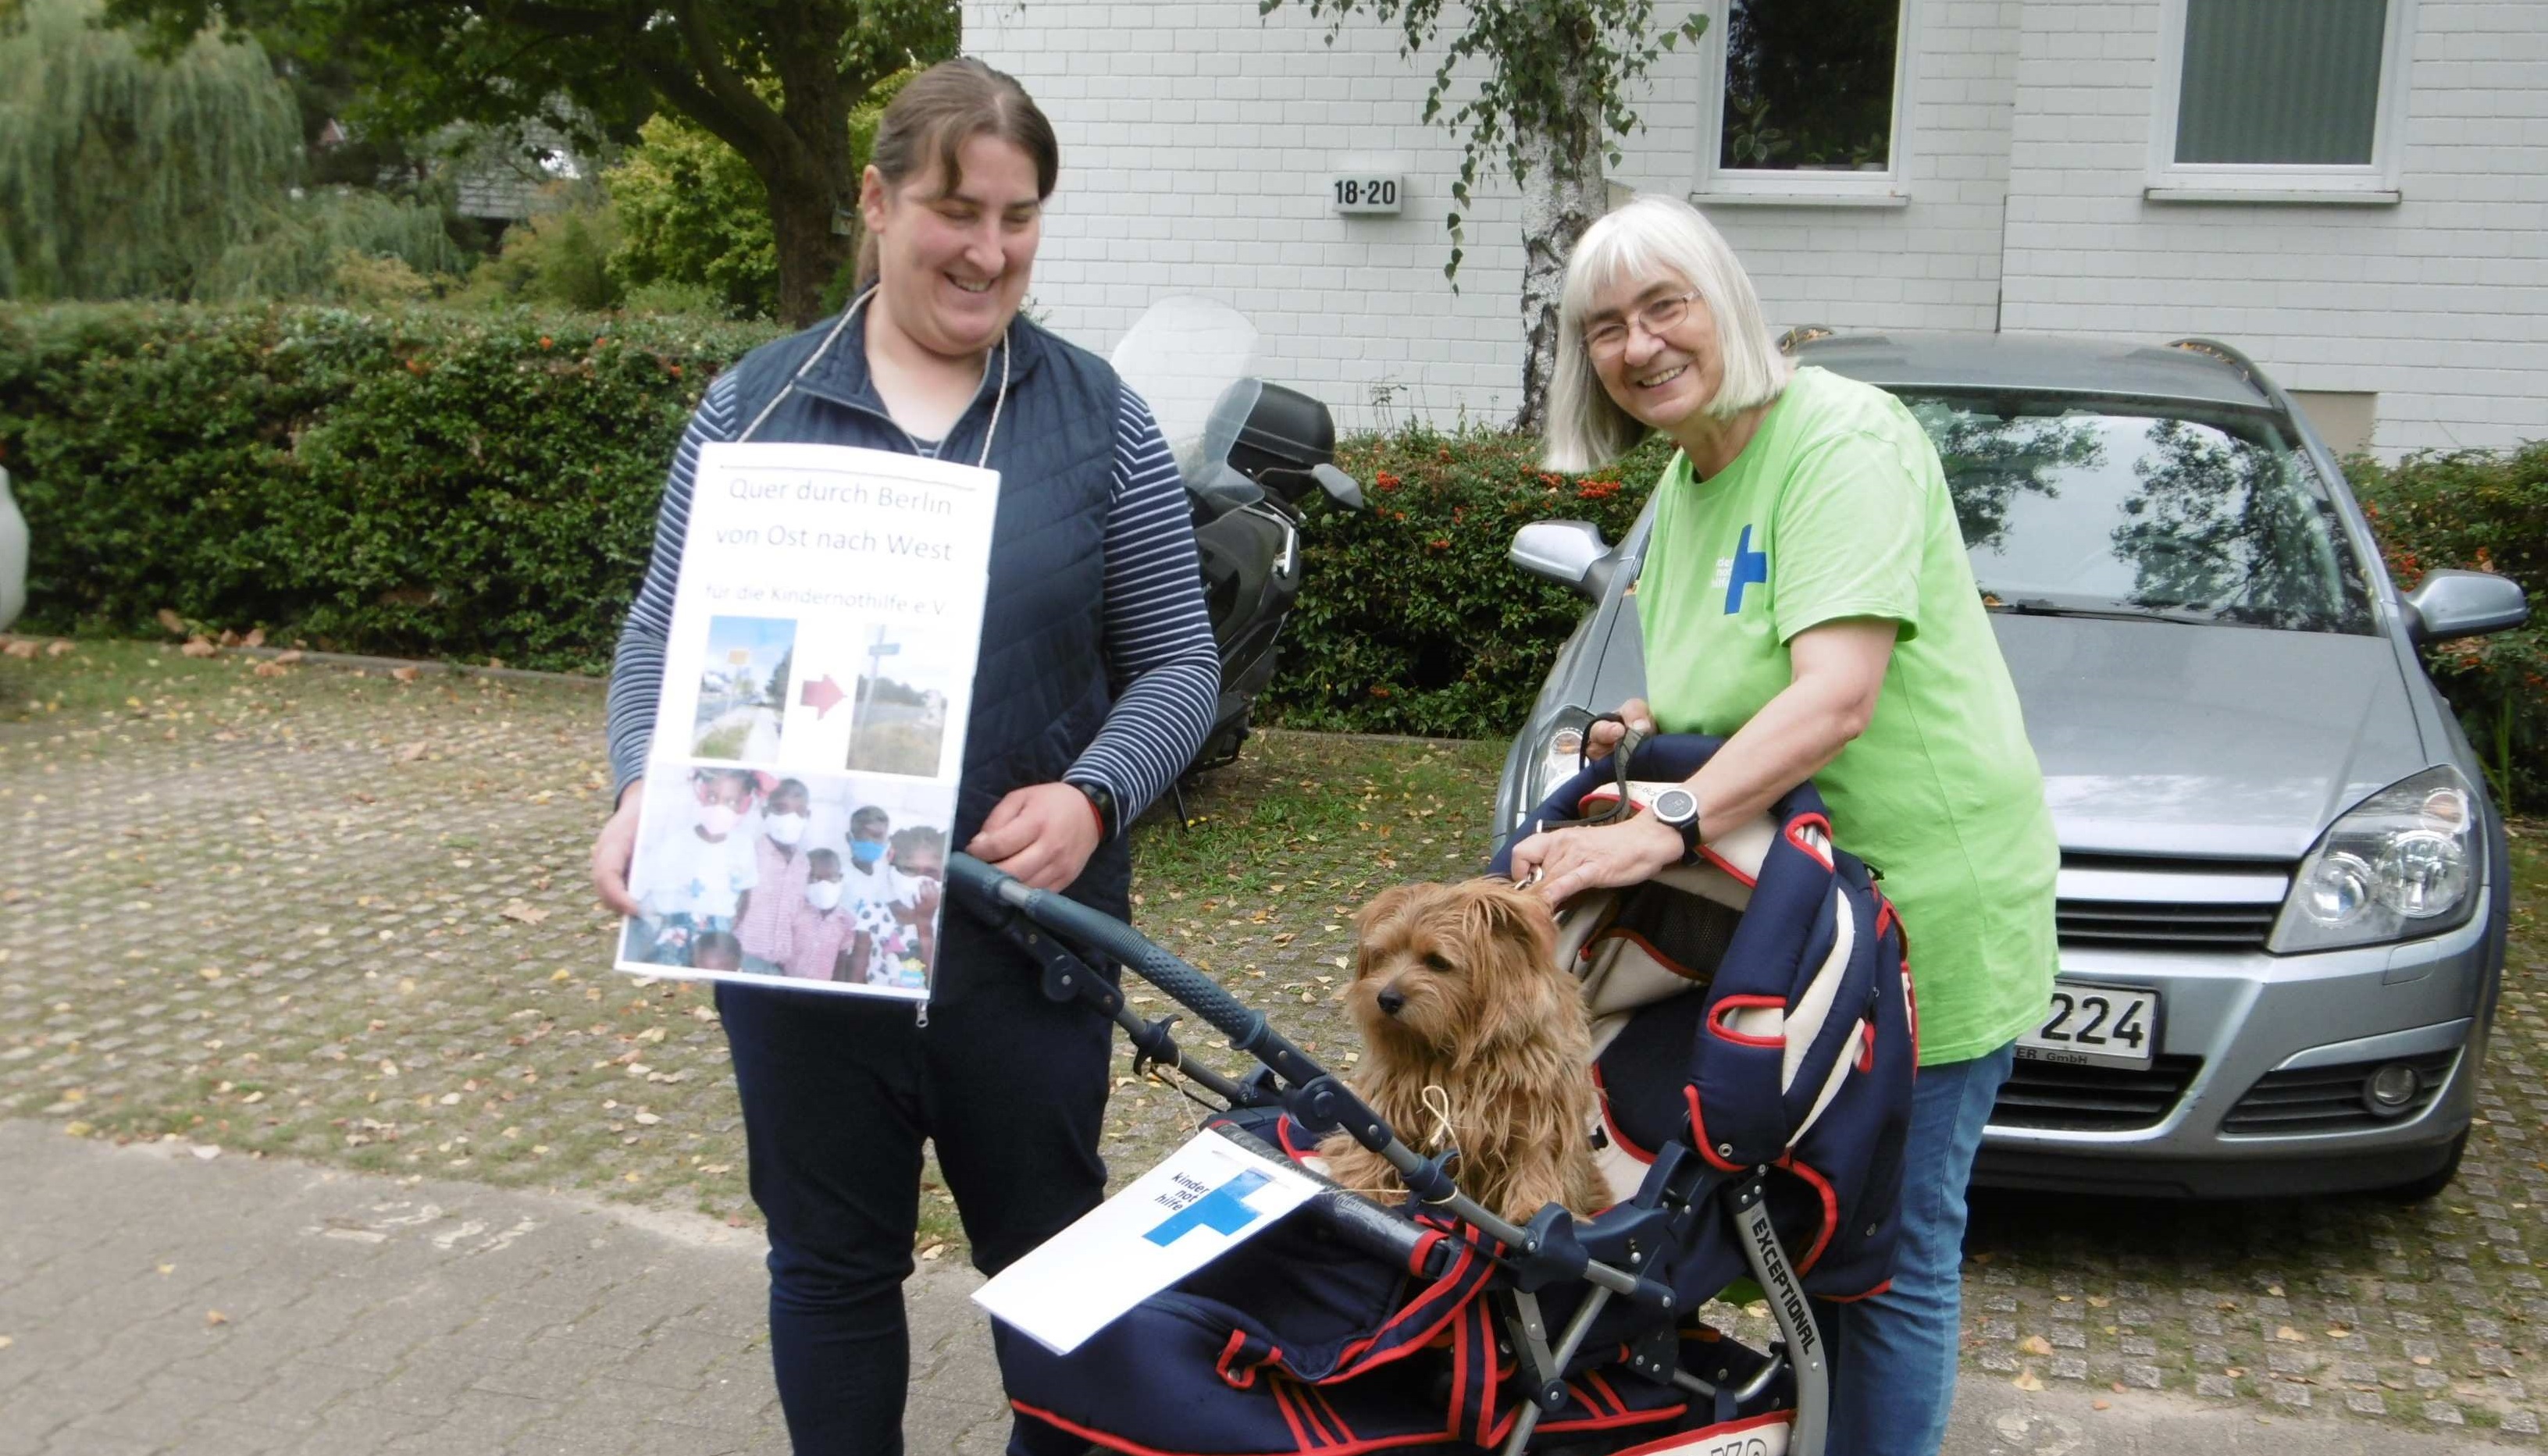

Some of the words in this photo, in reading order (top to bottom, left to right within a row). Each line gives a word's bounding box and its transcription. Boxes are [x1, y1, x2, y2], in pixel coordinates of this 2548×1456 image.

[1334, 180, 1396, 205] 18-20
[729, 477, 789, 501] Quer
[796, 479, 868, 504] durch
[877, 486, 953, 516] Berlin
[715, 526, 760, 546] von
[766, 524, 809, 547] Ost
[817, 529, 878, 552] nach
[886, 532, 953, 562] West
[736, 586, 766, 601] die
[771, 586, 907, 611] Kindernothilfe
[2046, 1052, 2088, 1065] GmbH
[1171, 1171, 1210, 1194] kinder
[1154, 1193, 1184, 1212] hilfe
[1174, 1188, 1199, 1204] not
[1752, 1216, 1818, 1356] EXCEPTIONAL
